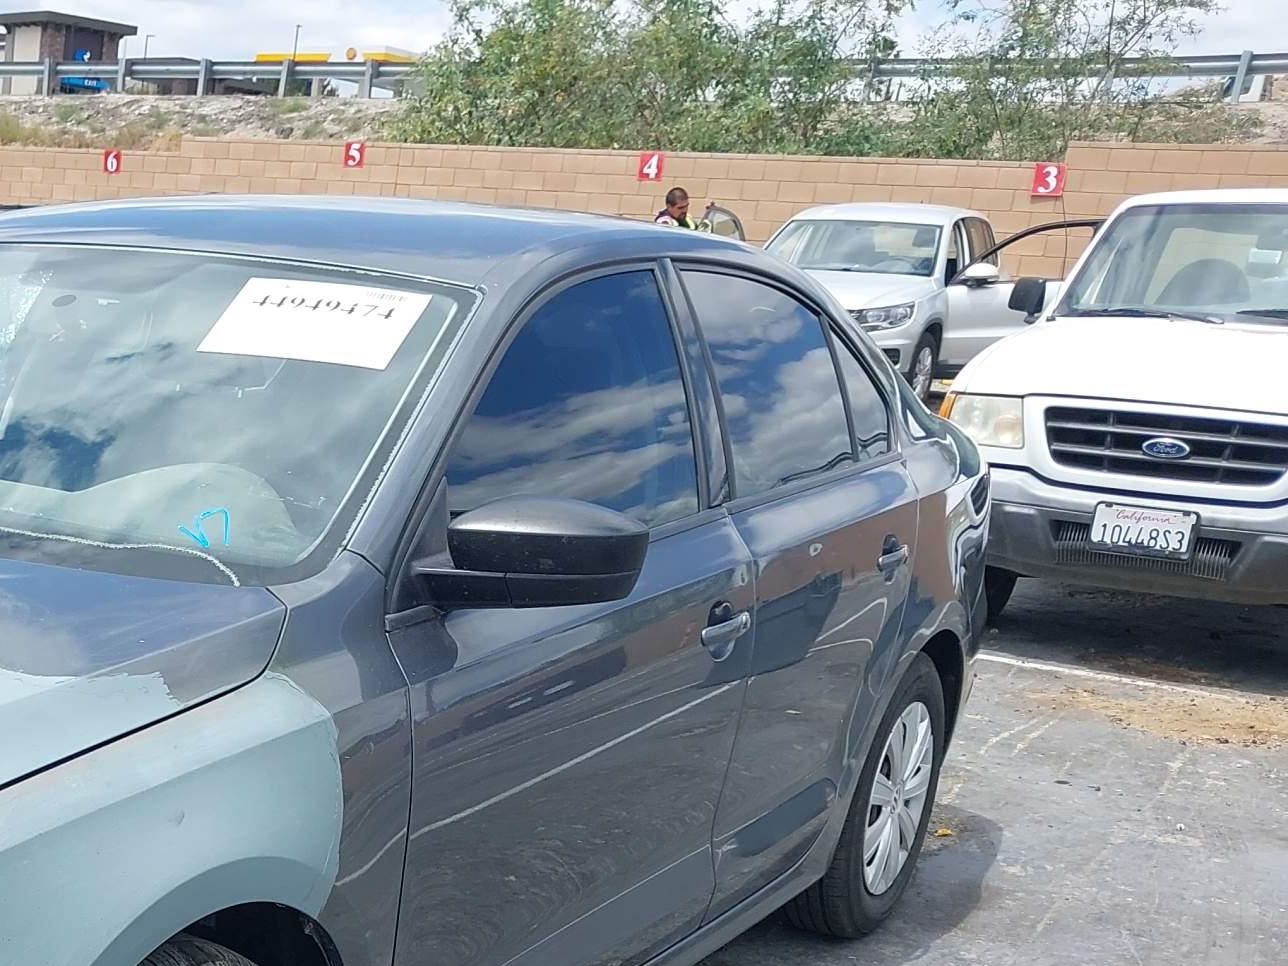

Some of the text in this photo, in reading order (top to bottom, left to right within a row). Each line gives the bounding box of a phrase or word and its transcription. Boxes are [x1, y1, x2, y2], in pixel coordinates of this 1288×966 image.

[106, 151, 117, 172] 6
[347, 143, 361, 166] 5
[643, 153, 659, 179] 4
[1037, 166, 1058, 193] 3
